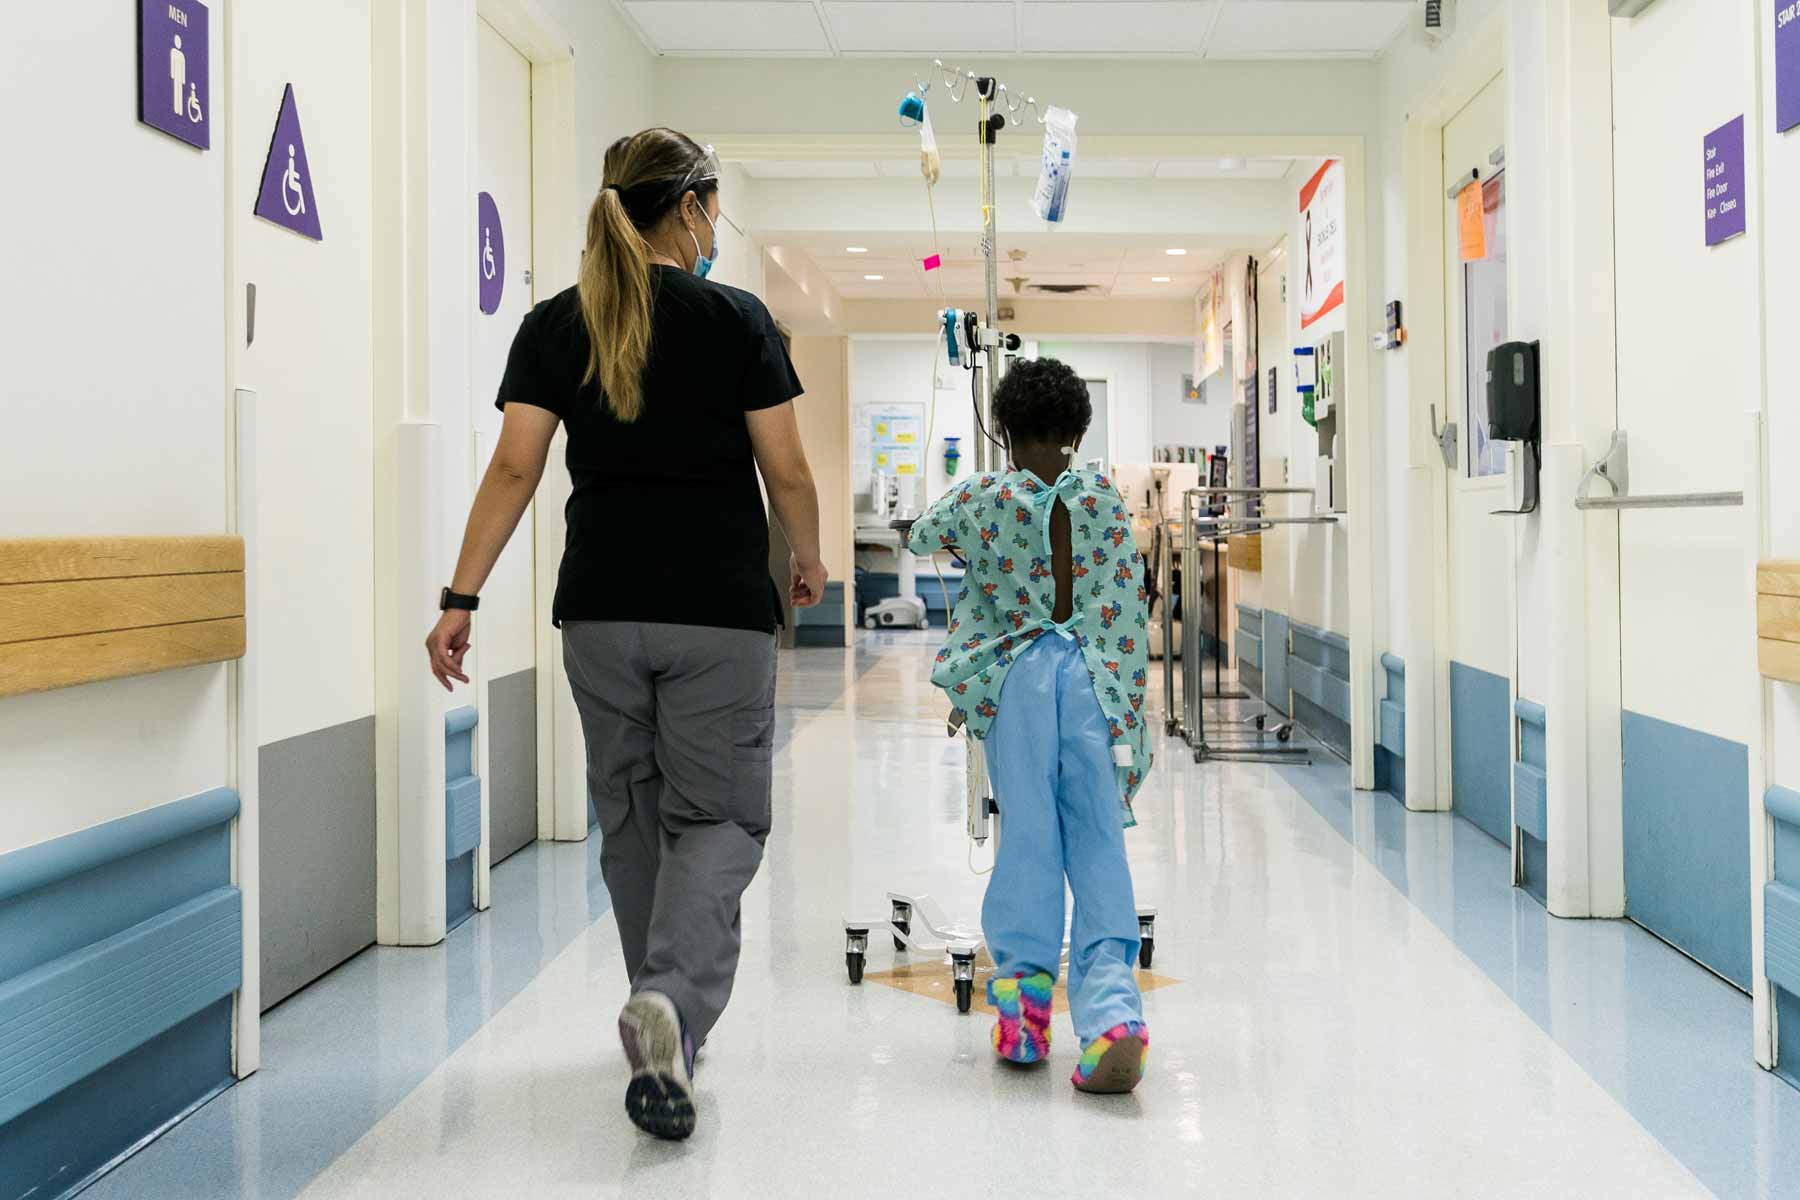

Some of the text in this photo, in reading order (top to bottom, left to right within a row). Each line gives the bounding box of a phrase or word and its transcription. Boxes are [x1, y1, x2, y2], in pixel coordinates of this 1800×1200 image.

[168, 4, 187, 28] MEN
[1777, 4, 1796, 28] STAIR
[1706, 162, 1725, 180] Fire Exit
[1706, 182, 1728, 200] Fire Door
